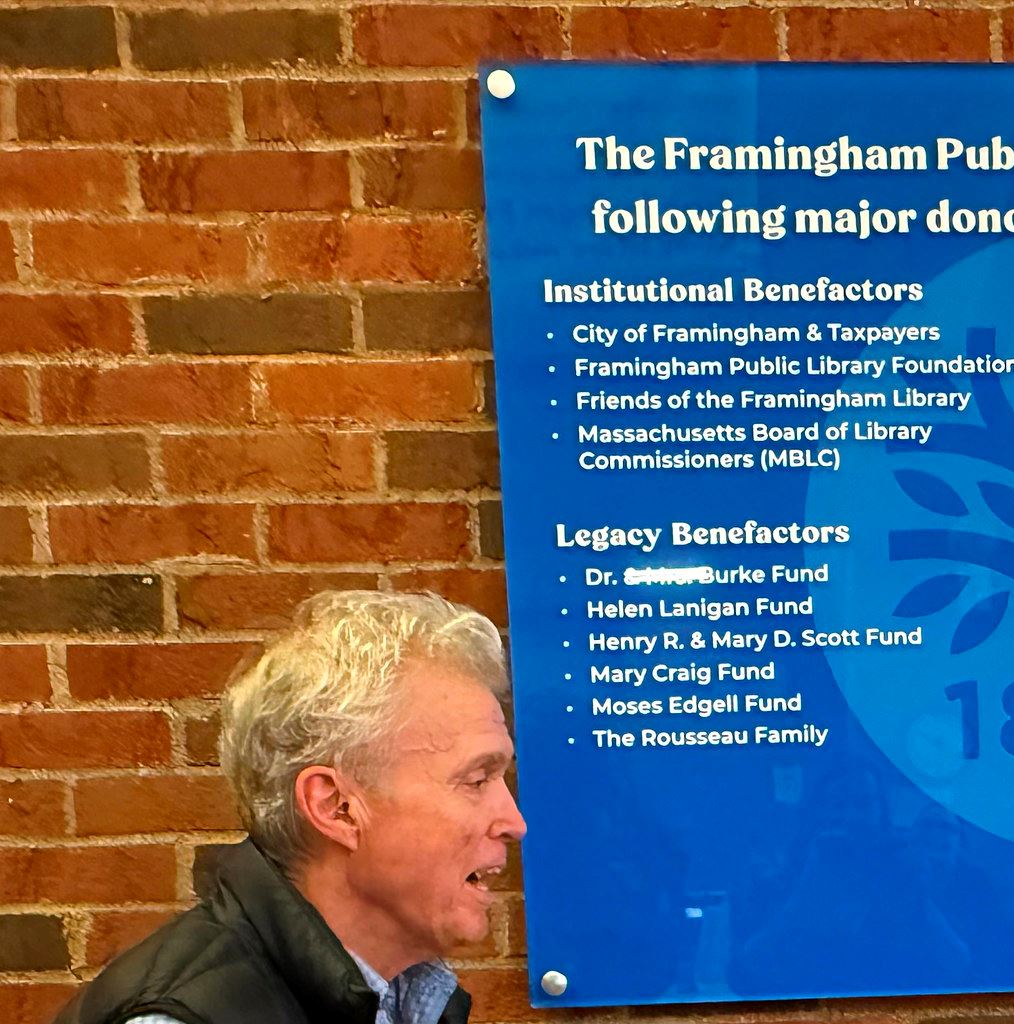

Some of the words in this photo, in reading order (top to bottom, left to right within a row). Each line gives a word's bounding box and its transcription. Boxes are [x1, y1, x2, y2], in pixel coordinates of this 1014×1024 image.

[575, 135, 656, 170] The
[663, 135, 928, 177] Framingham
[591, 198, 787, 241] following
[794, 199, 918, 240] major
[543, 276, 734, 303] Institutional
[743, 276, 924, 302] Benefactors
[572, 323, 619, 348] City
[623, 323, 648, 343] of
[652, 322, 800, 347] Framingham
[806, 323, 823, 342] &
[826, 323, 941, 346] Taxpayers
[575, 356, 723, 380] Framingham
[729, 355, 801, 376] Public
[807, 355, 886, 379] Library
[576, 390, 662, 410] Friends
[667, 389, 691, 410] of
[695, 389, 735, 409] the
[740, 388, 886, 412] Framingham
[893, 387, 972, 411] Library
[578, 423, 747, 444] Massachusetts
[752, 421, 819, 442] Board
[825, 421, 849, 441] of
[854, 420, 933, 445] Library
[578, 449, 755, 470] Commissioners
[760, 447, 841, 472] (MBLC)
[556, 523, 663, 553] Legacy
[671, 519, 850, 546] Benefactors
[585, 567, 618, 586] Dr.
[698, 565, 766, 585] Burke
[771, 563, 830, 583] Fund
[587, 599, 653, 619] Helen
[659, 597, 750, 621] Lanigan
[756, 596, 813, 616] Fund
[588, 633, 658, 655] Henry
[662, 631, 685, 650] R.
[689, 631, 706, 650] &
[711, 630, 768, 653] Mary
[773, 629, 797, 648] D.
[801, 629, 861, 647] Scott
[865, 626, 923, 646] Fund
[590, 665, 648, 687] Mary
[651, 662, 712, 686] Craig
[717, 661, 775, 681] Fund
[592, 697, 664, 716] Moses
[668, 693, 739, 718] Edgell
[745, 692, 802, 712] Fund
[592, 729, 636, 748] The
[641, 728, 748, 747] Rousseau
[754, 723, 829, 747] Family
